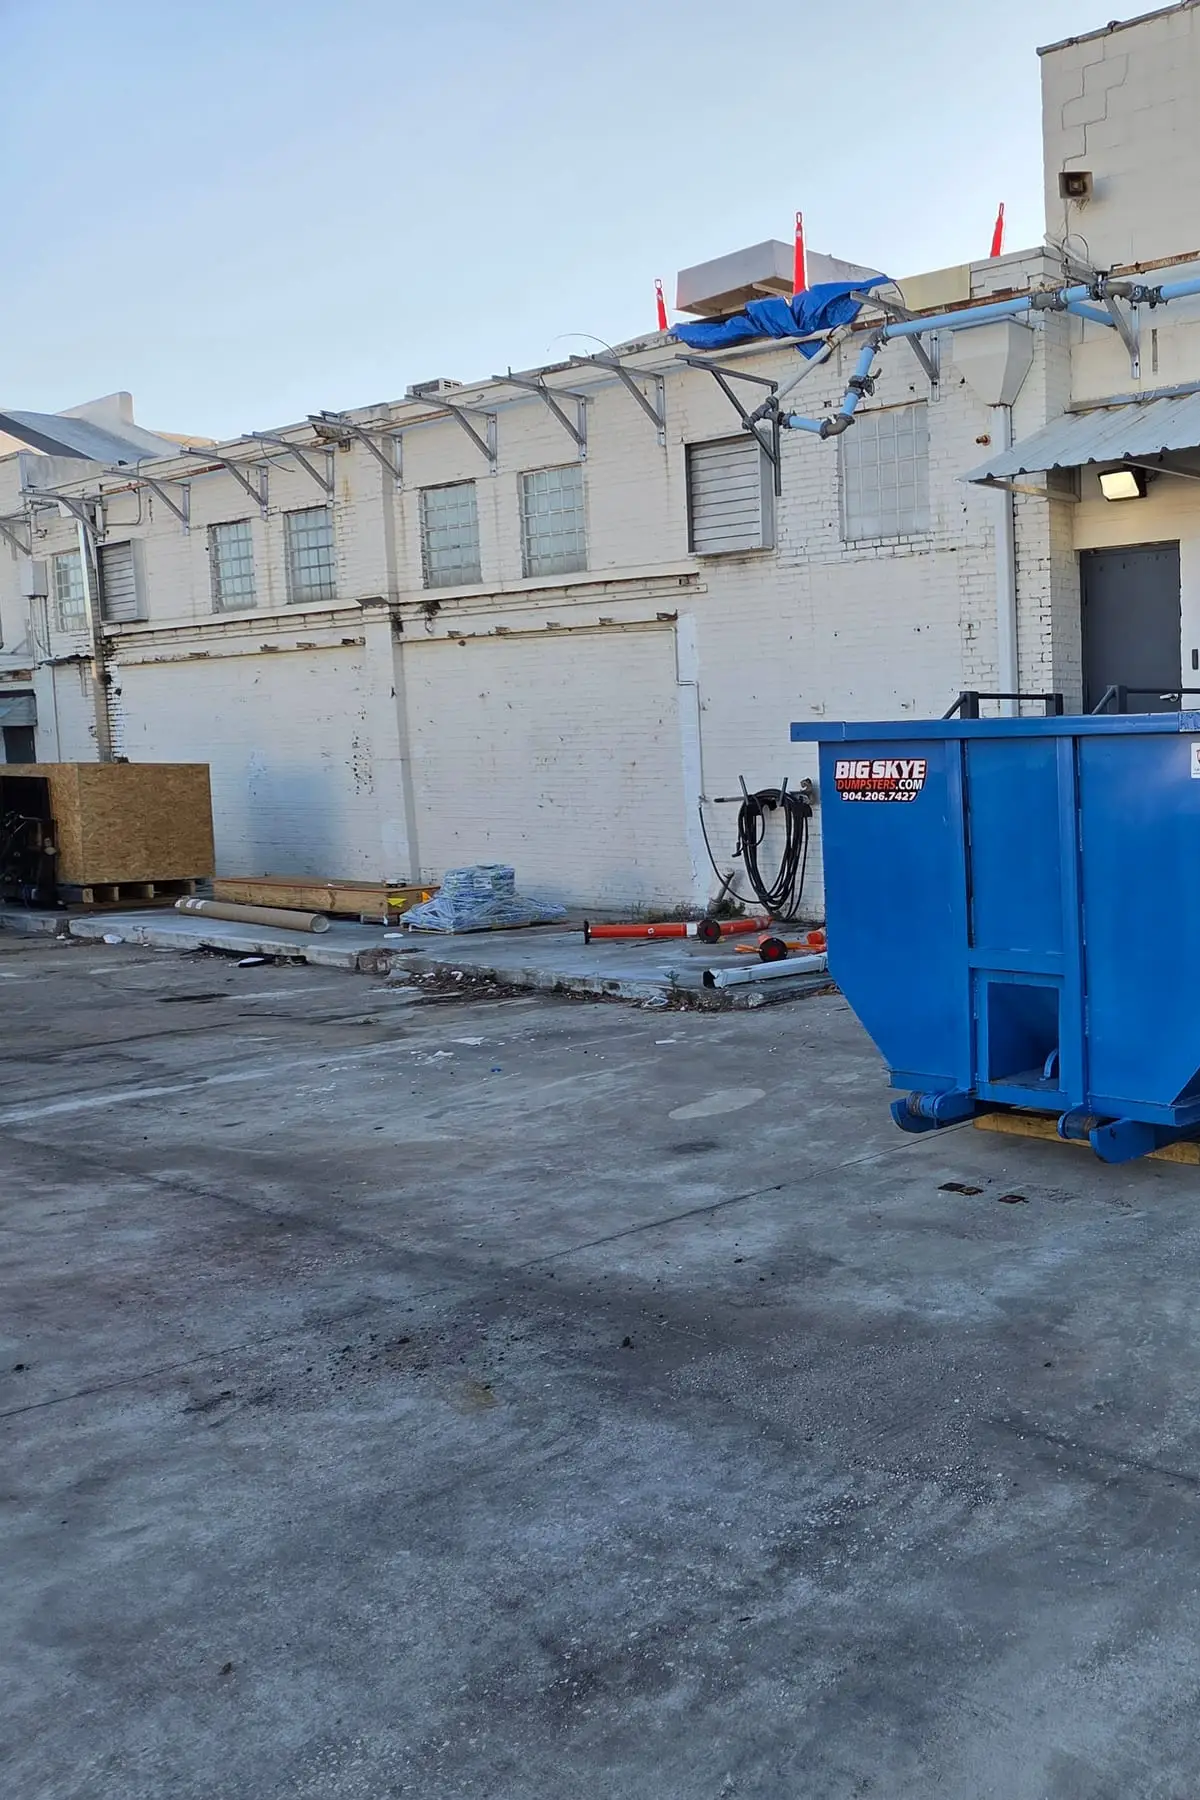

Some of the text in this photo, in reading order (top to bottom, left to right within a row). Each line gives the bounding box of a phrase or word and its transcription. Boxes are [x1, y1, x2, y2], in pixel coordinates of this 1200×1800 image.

[835, 760, 926, 779] BIG SKYE
[837, 779, 923, 790] DUMPSTERS.COM
[842, 791, 917, 801] 904.206.7427
